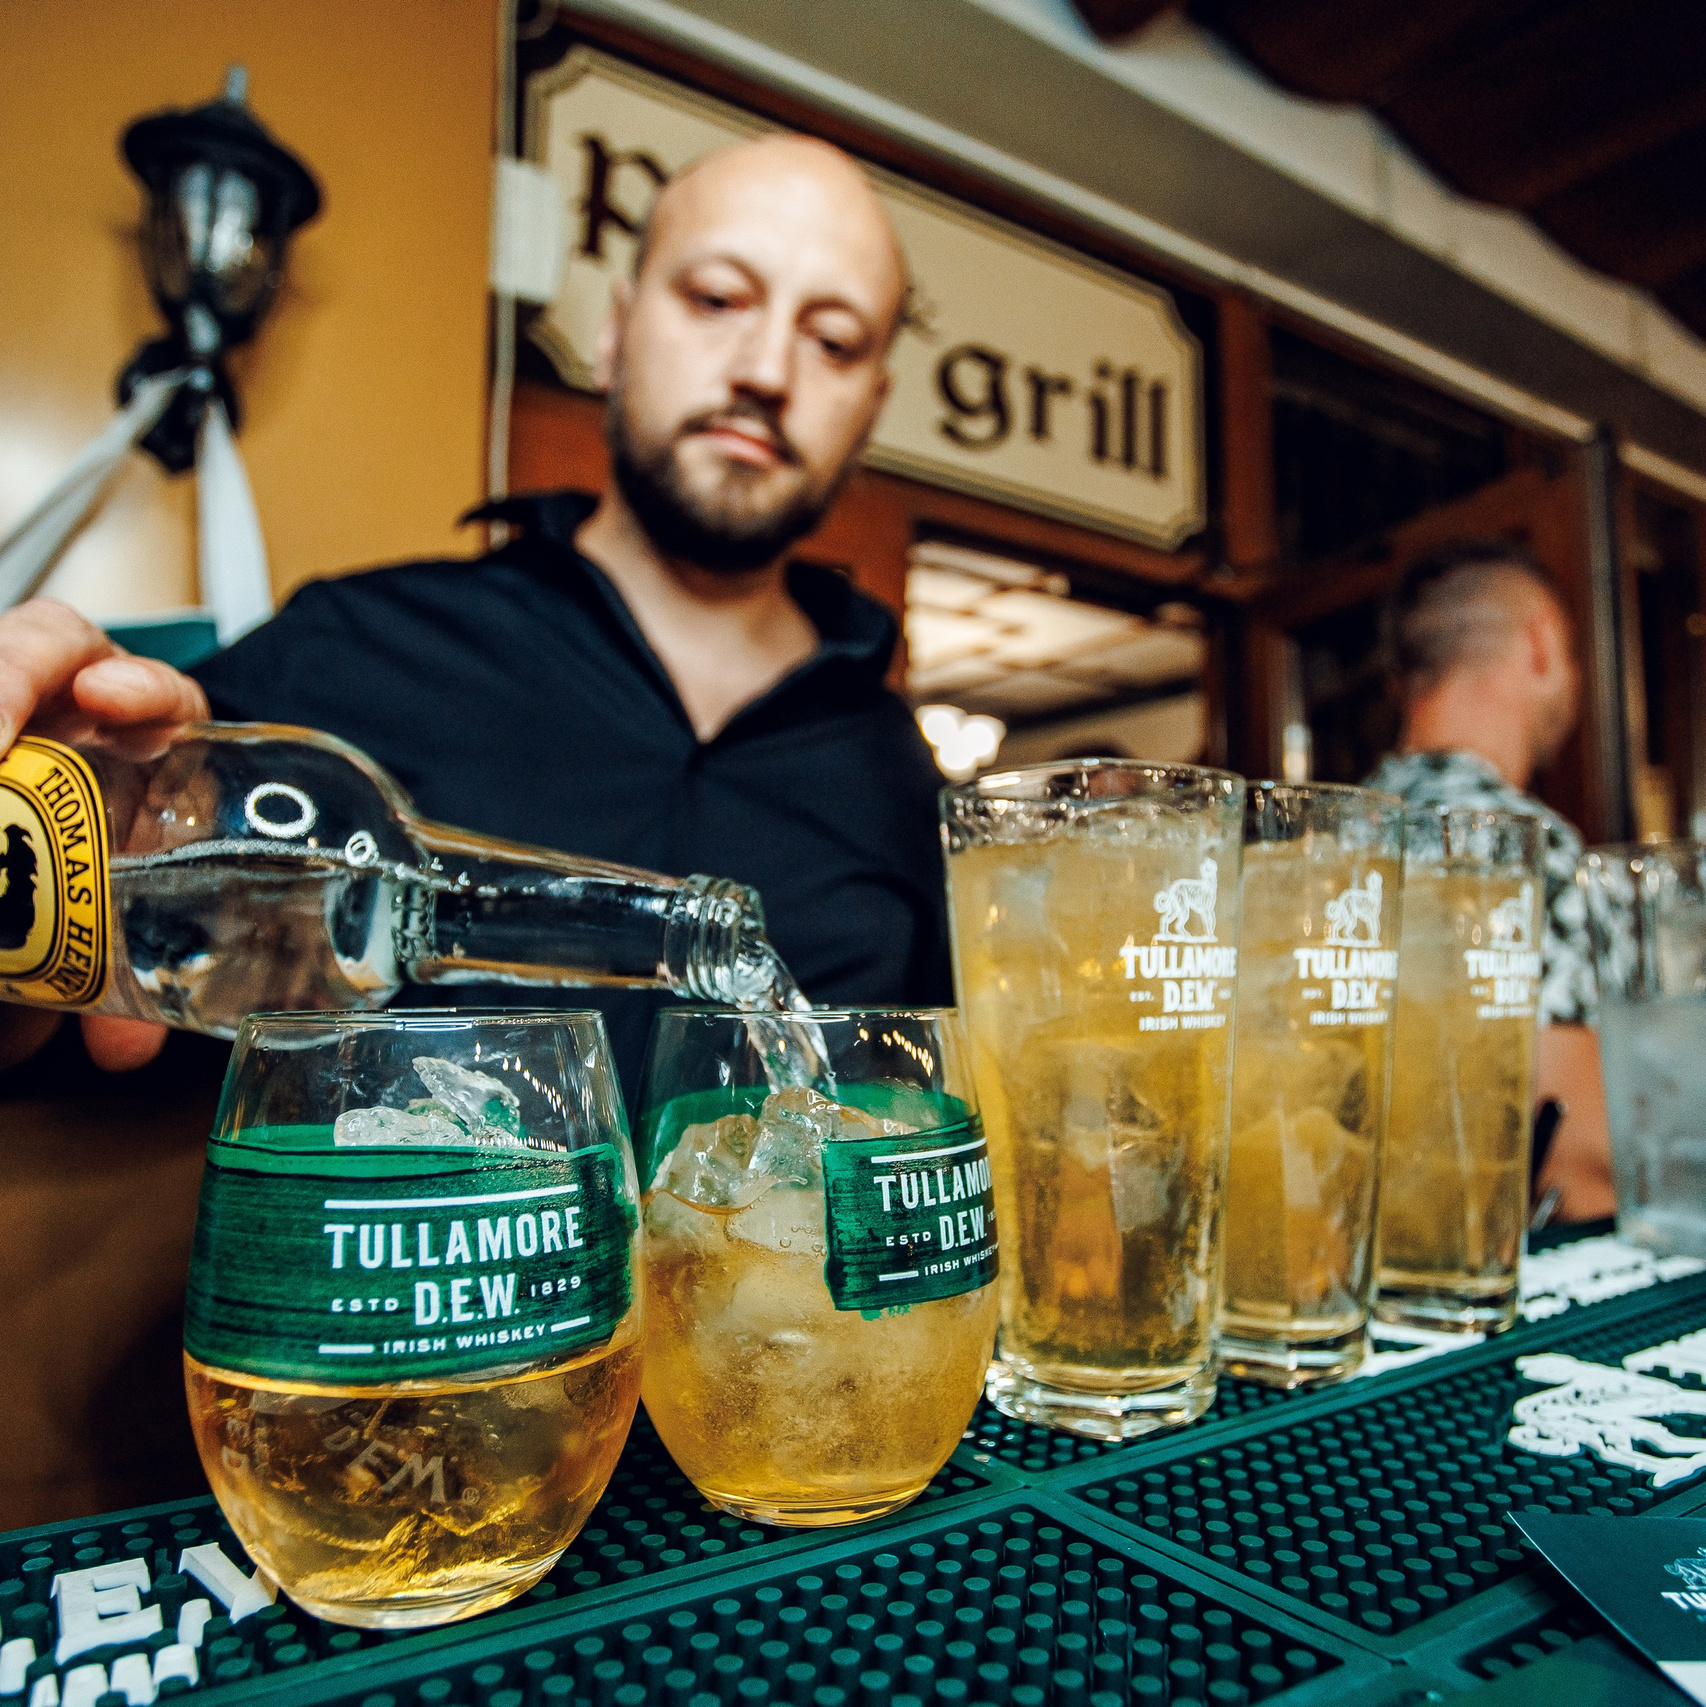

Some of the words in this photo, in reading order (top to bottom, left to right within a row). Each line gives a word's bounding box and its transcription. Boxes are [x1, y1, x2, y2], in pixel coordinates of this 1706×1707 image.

[935, 343, 1168, 480] grill
[35, 767, 92, 905] THOMAS
[1119, 946, 1237, 979] TULLAMORE
[324, 1206, 584, 1269] TULLAMORE
[885, 1231, 932, 1247] ESTD
[938, 1205, 988, 1251] D.E.W.
[924, 1258, 961, 1276] IRISH
[331, 1297, 400, 1313] ESTD
[414, 1272, 520, 1326] D.E.W.
[530, 1275, 582, 1298] 1829
[383, 1338, 447, 1354] IRISH
[456, 1323, 546, 1349] WHISKEY
